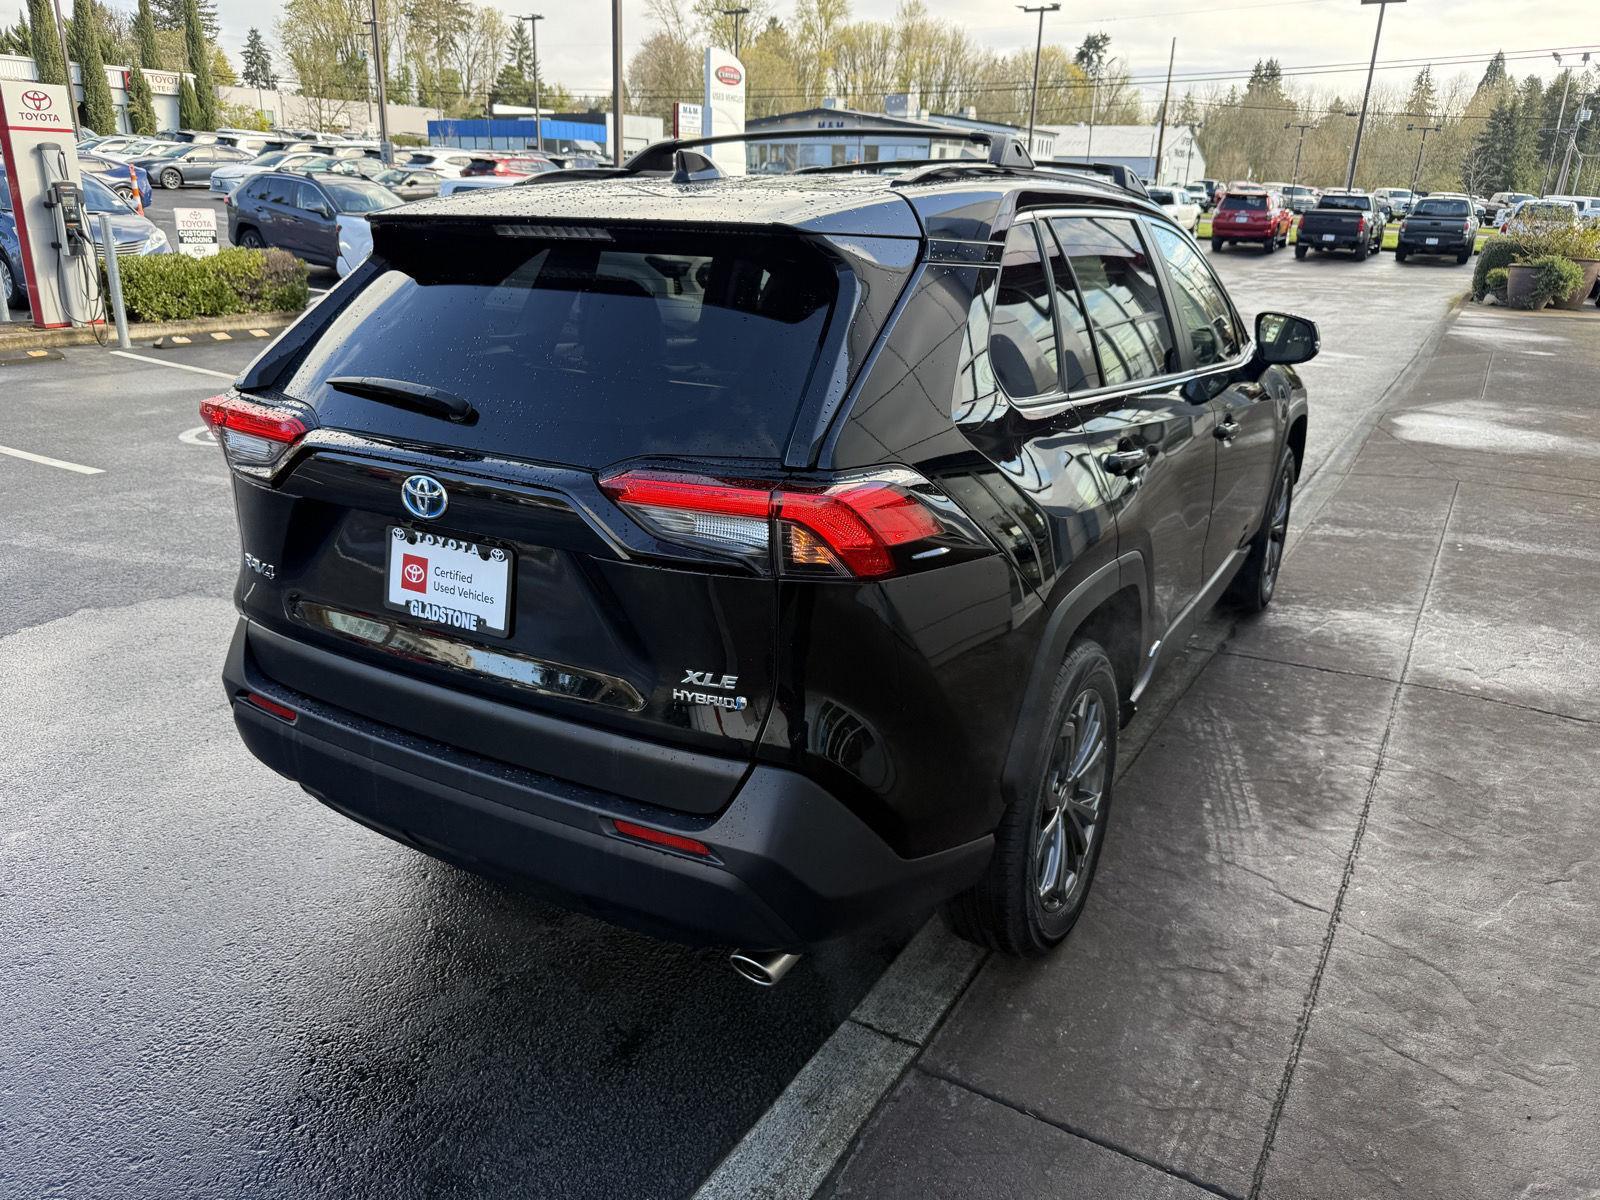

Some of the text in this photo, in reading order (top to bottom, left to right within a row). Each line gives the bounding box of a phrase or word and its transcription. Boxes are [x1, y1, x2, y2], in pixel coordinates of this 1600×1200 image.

[150, 75, 179, 84] TOYOT
[19, 111, 60, 122] TOYOTA
[181, 220, 212, 228] TOYOTA
[415, 532, 480, 555] TOYOTA
[434, 566, 473, 584] Certified
[433, 581, 495, 605] Used Vehicles
[409, 600, 478, 631] GLADSTONE
[680, 669, 739, 690] XLE
[672, 688, 736, 709] HYBRID
